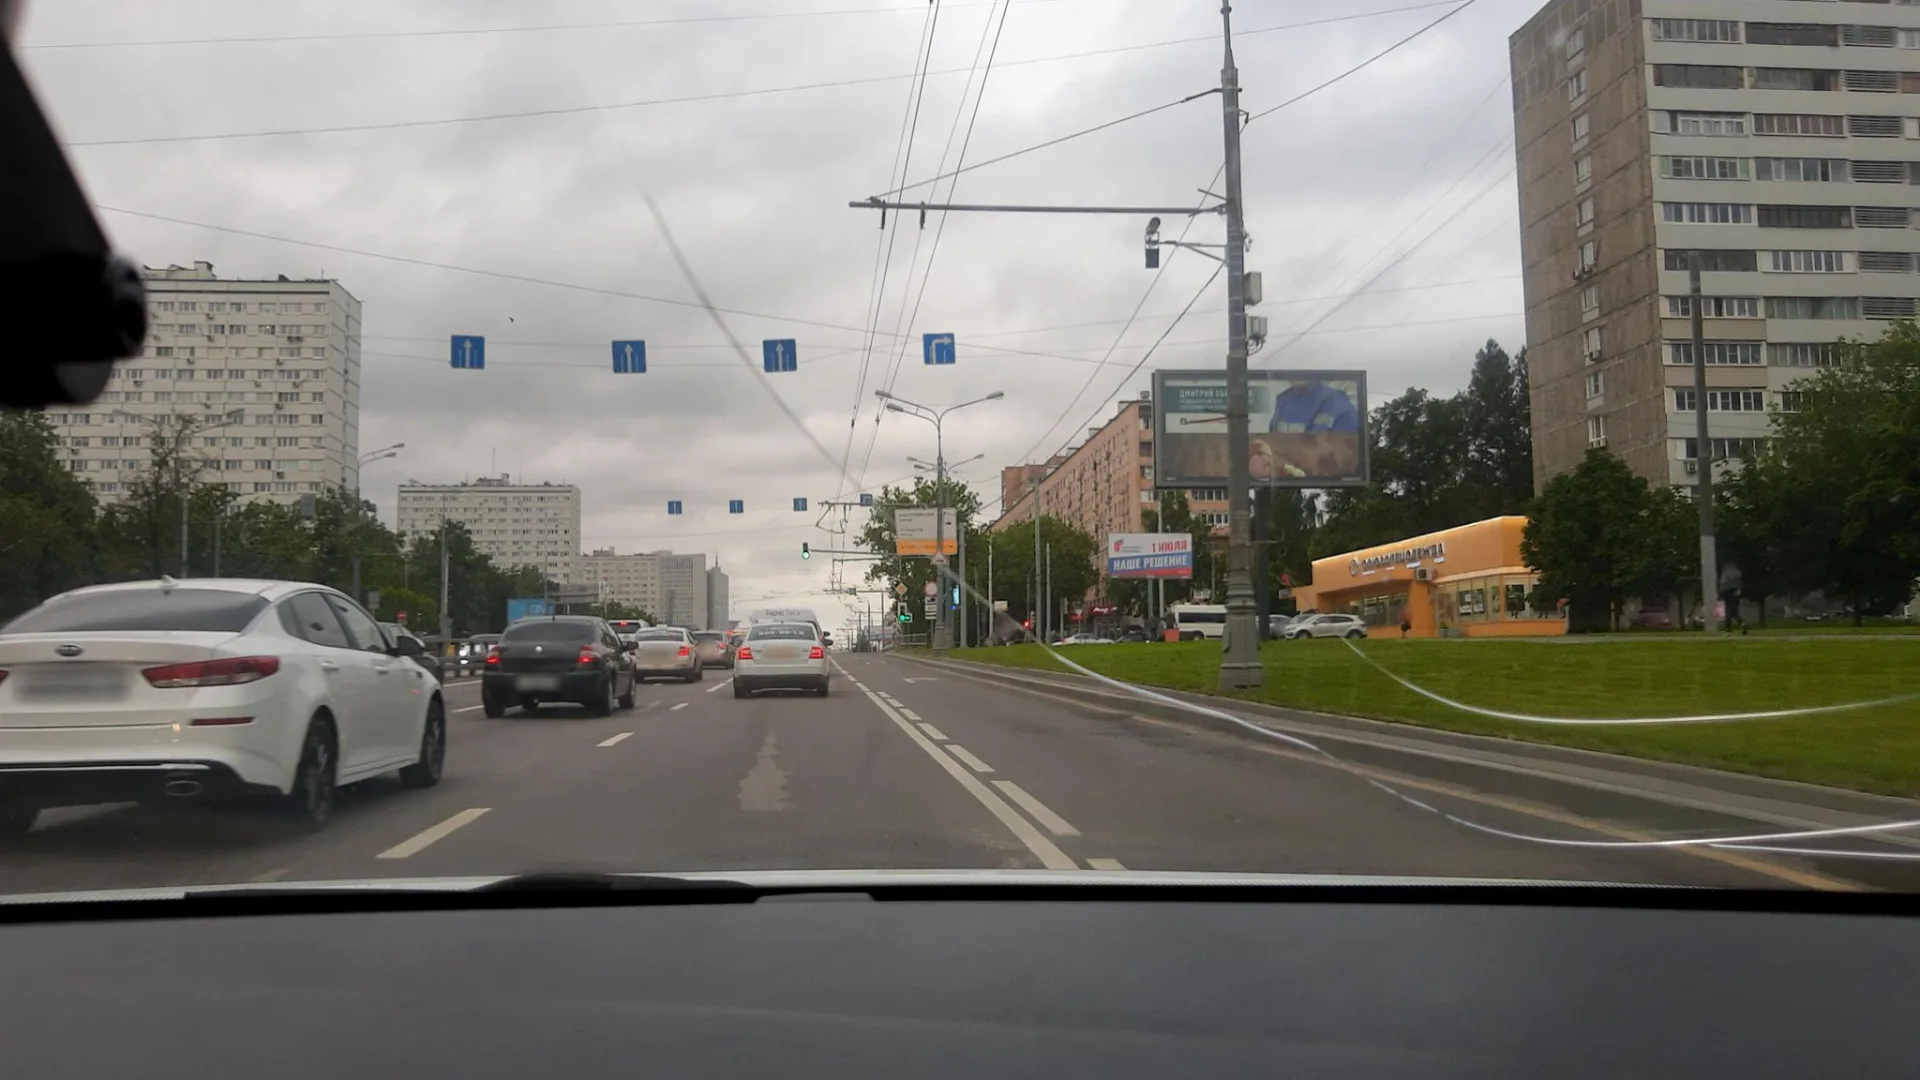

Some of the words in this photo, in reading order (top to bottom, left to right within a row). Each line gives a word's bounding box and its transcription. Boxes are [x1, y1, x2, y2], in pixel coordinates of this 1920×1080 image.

[1179, 388, 1214, 398] ДМИТРИЙ
[1158, 540, 1187, 552] ИЮЛЯ
[1113, 558, 1141, 571] НАШЕ
[1143, 554, 1189, 569] РЕШЕНИЕ
